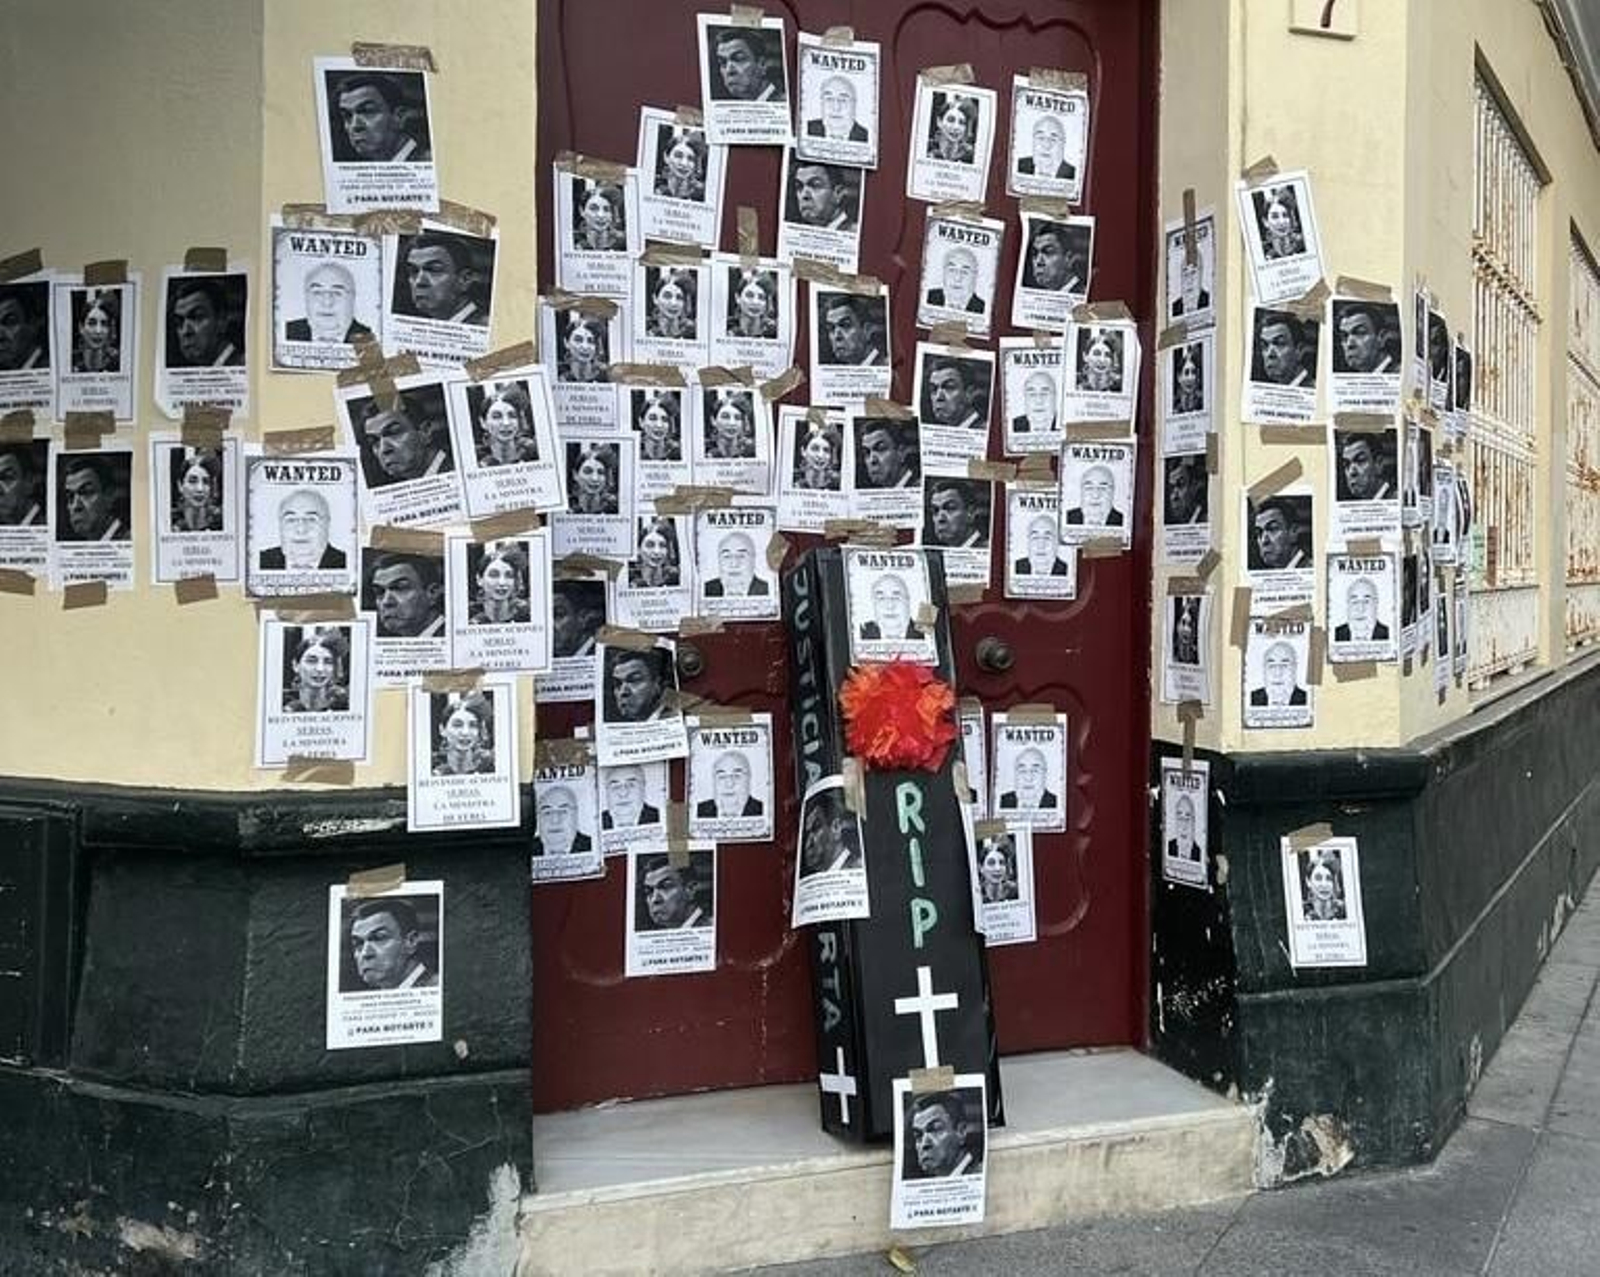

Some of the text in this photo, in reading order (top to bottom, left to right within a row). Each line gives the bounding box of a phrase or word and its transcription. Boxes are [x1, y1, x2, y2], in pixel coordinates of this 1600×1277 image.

[811, 52, 866, 72] WANTED
[1024, 94, 1076, 113] WANTED
[355, 195, 379, 203] PARA
[938, 224, 990, 246] WANTED
[290, 236, 367, 257] WANTED
[1072, 447, 1125, 461] WANTED
[263, 465, 342, 482] WANTED
[393, 513, 417, 523] PARA
[706, 512, 765, 526] WANTED
[857, 553, 915, 569] WANTED
[1337, 559, 1386, 572] WANTED
[564, 683, 594, 692] BOTART
[701, 731, 759, 746] WANTED
[1005, 729, 1054, 742] WANTED
[535, 765, 586, 779] ANTED
[895, 781, 938, 948] RIP
[355, 1025, 380, 1034] PARA
